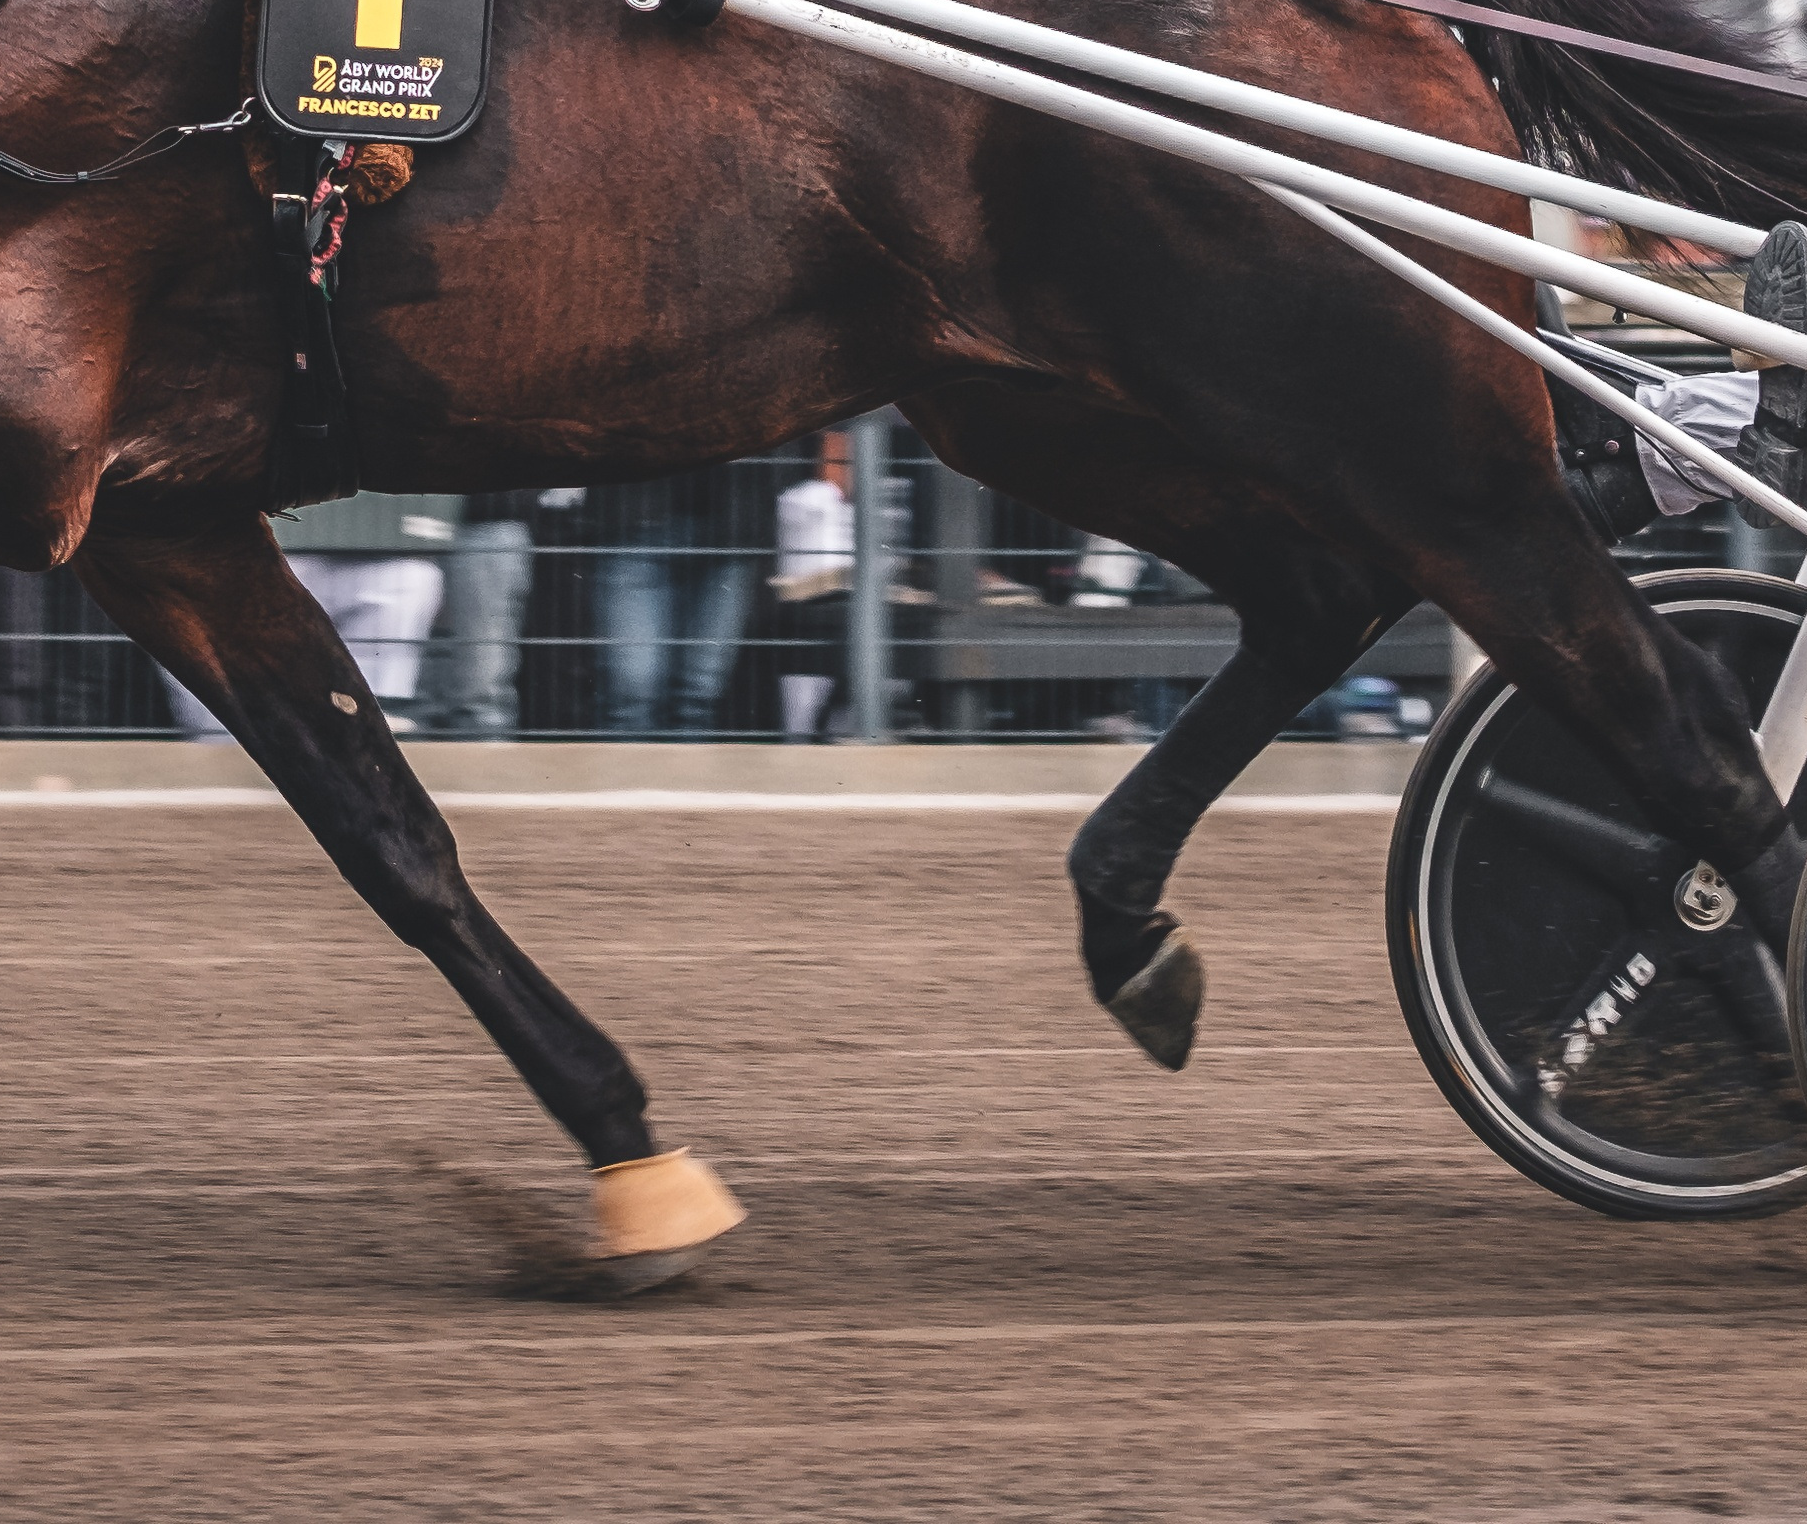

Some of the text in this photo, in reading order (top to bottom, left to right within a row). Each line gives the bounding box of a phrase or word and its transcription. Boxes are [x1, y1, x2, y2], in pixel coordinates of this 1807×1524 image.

[341, 59, 433, 81] ÅBY WORLD
[339, 78, 432, 97] GRAND PRIX
[299, 96, 441, 120] FRANCESCO ZET
